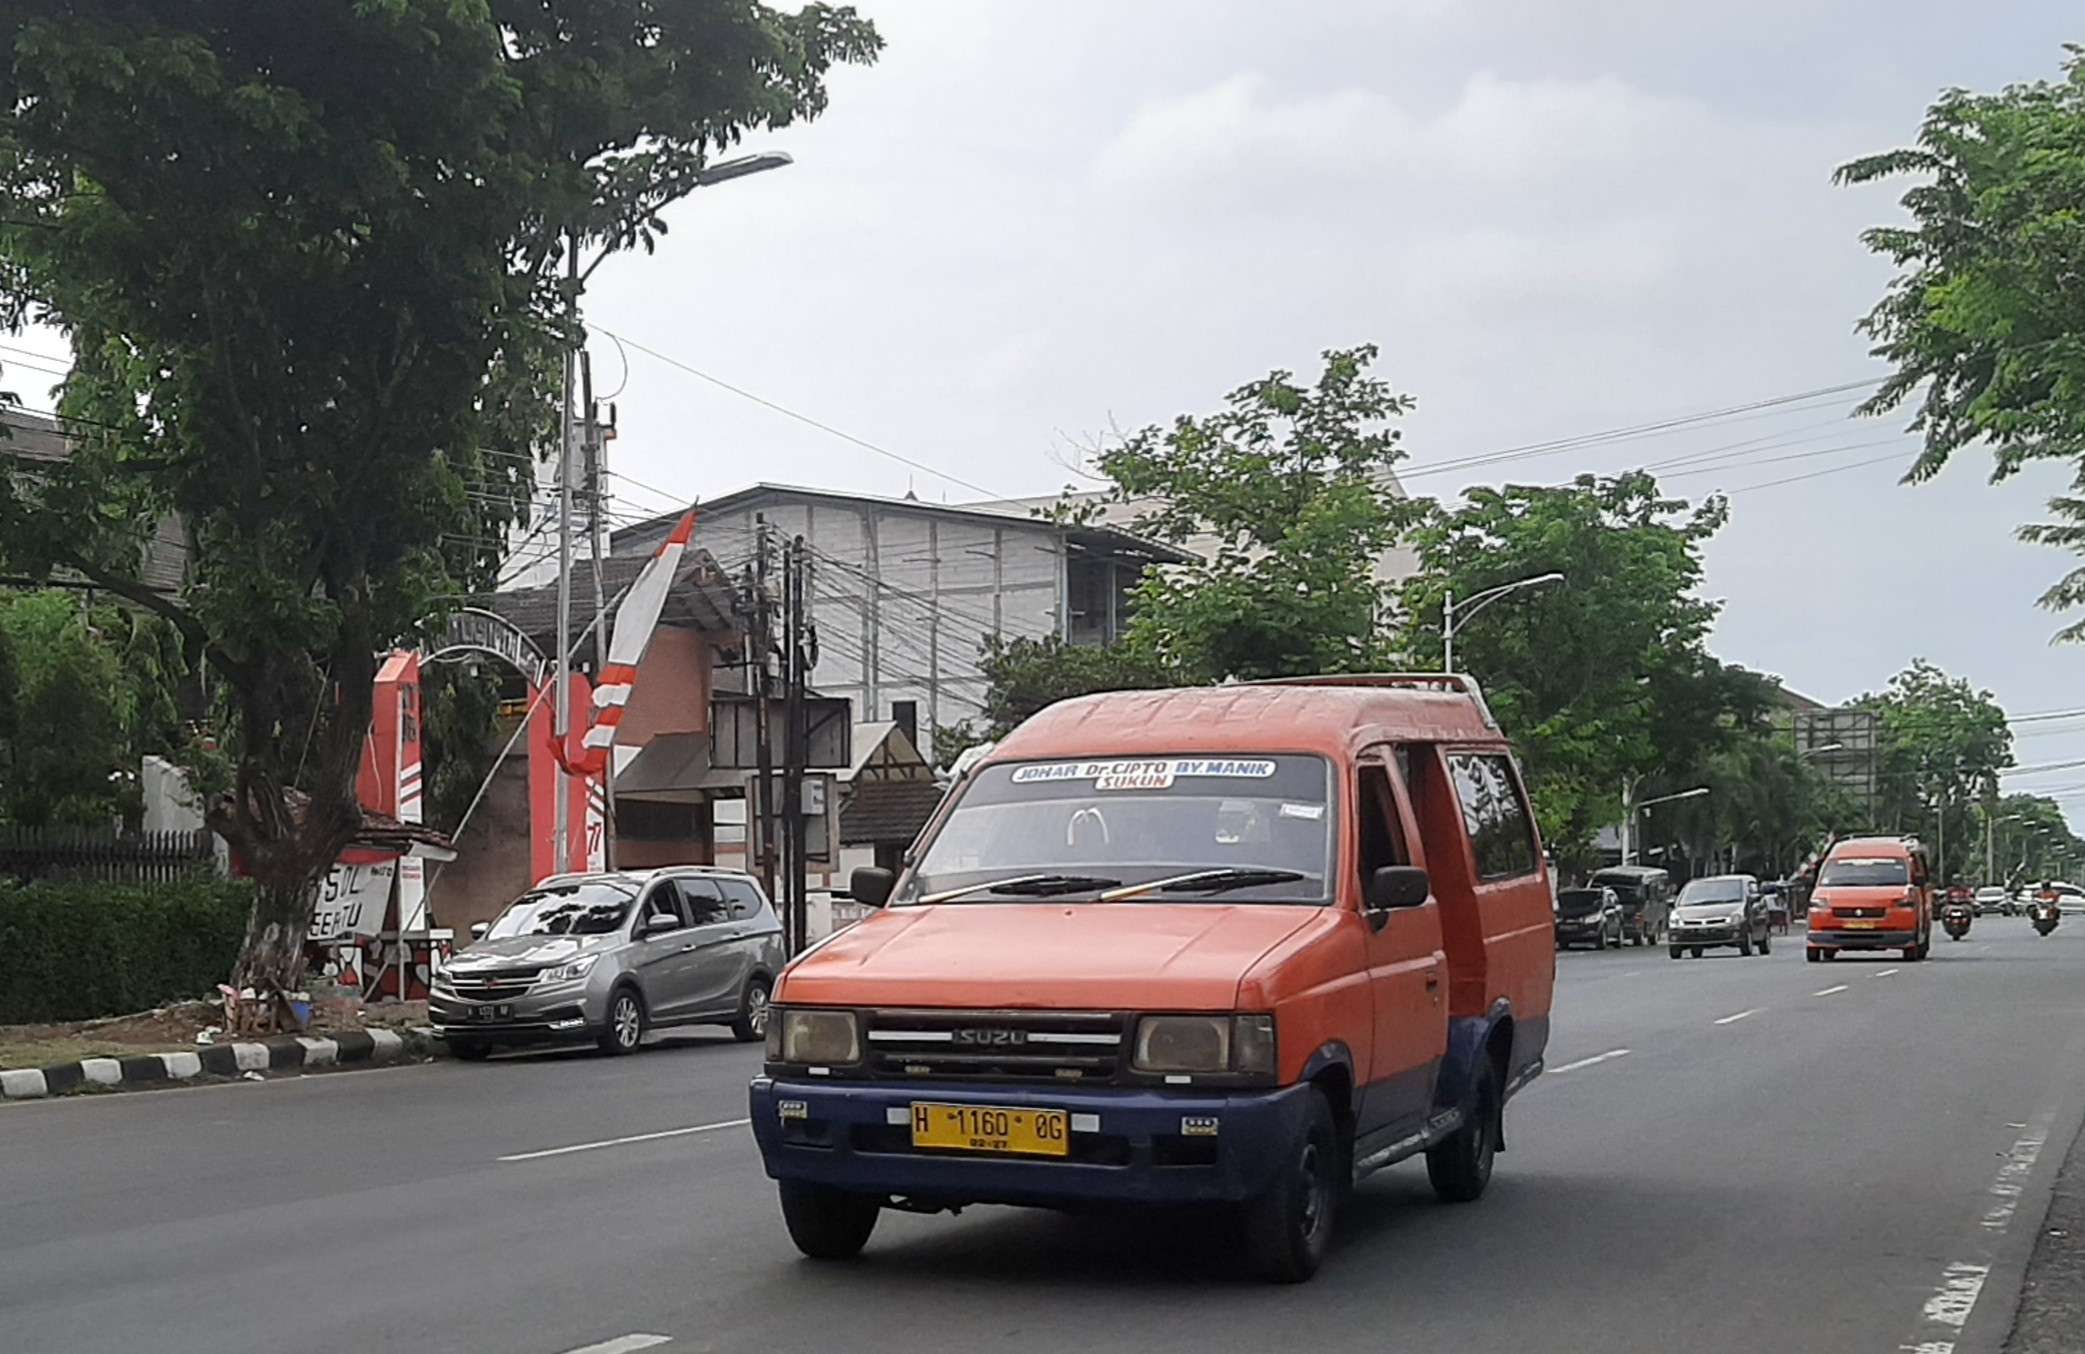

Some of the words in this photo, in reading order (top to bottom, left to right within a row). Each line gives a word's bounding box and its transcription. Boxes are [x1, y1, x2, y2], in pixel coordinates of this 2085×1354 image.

[1016, 764, 1083, 780] JOHAR
[1102, 775, 1169, 788] SUKUN
[915, 1106, 929, 1133] H
[956, 1109, 1009, 1137] 1160
